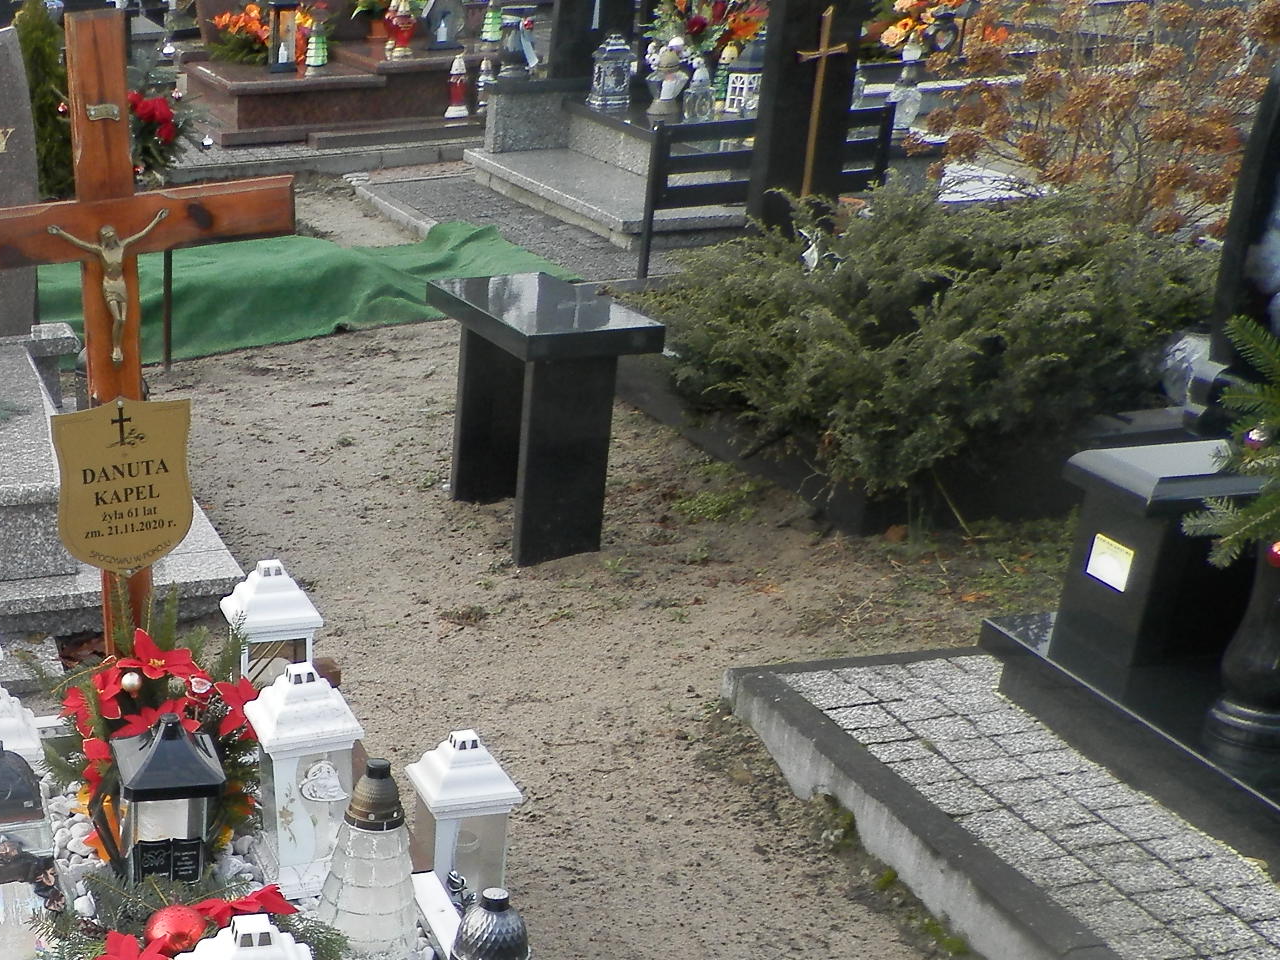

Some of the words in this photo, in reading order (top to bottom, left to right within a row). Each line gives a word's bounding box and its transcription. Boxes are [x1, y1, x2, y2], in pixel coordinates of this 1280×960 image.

[81, 458, 169, 485] DANUTA
[94, 484, 160, 507] KAPEL
[127, 507, 139, 518] 61
[143, 505, 158, 516] lat
[84, 529, 105, 540] zm.
[107, 518, 165, 536] 21.11.2020
[167, 519, 177, 528] r.
